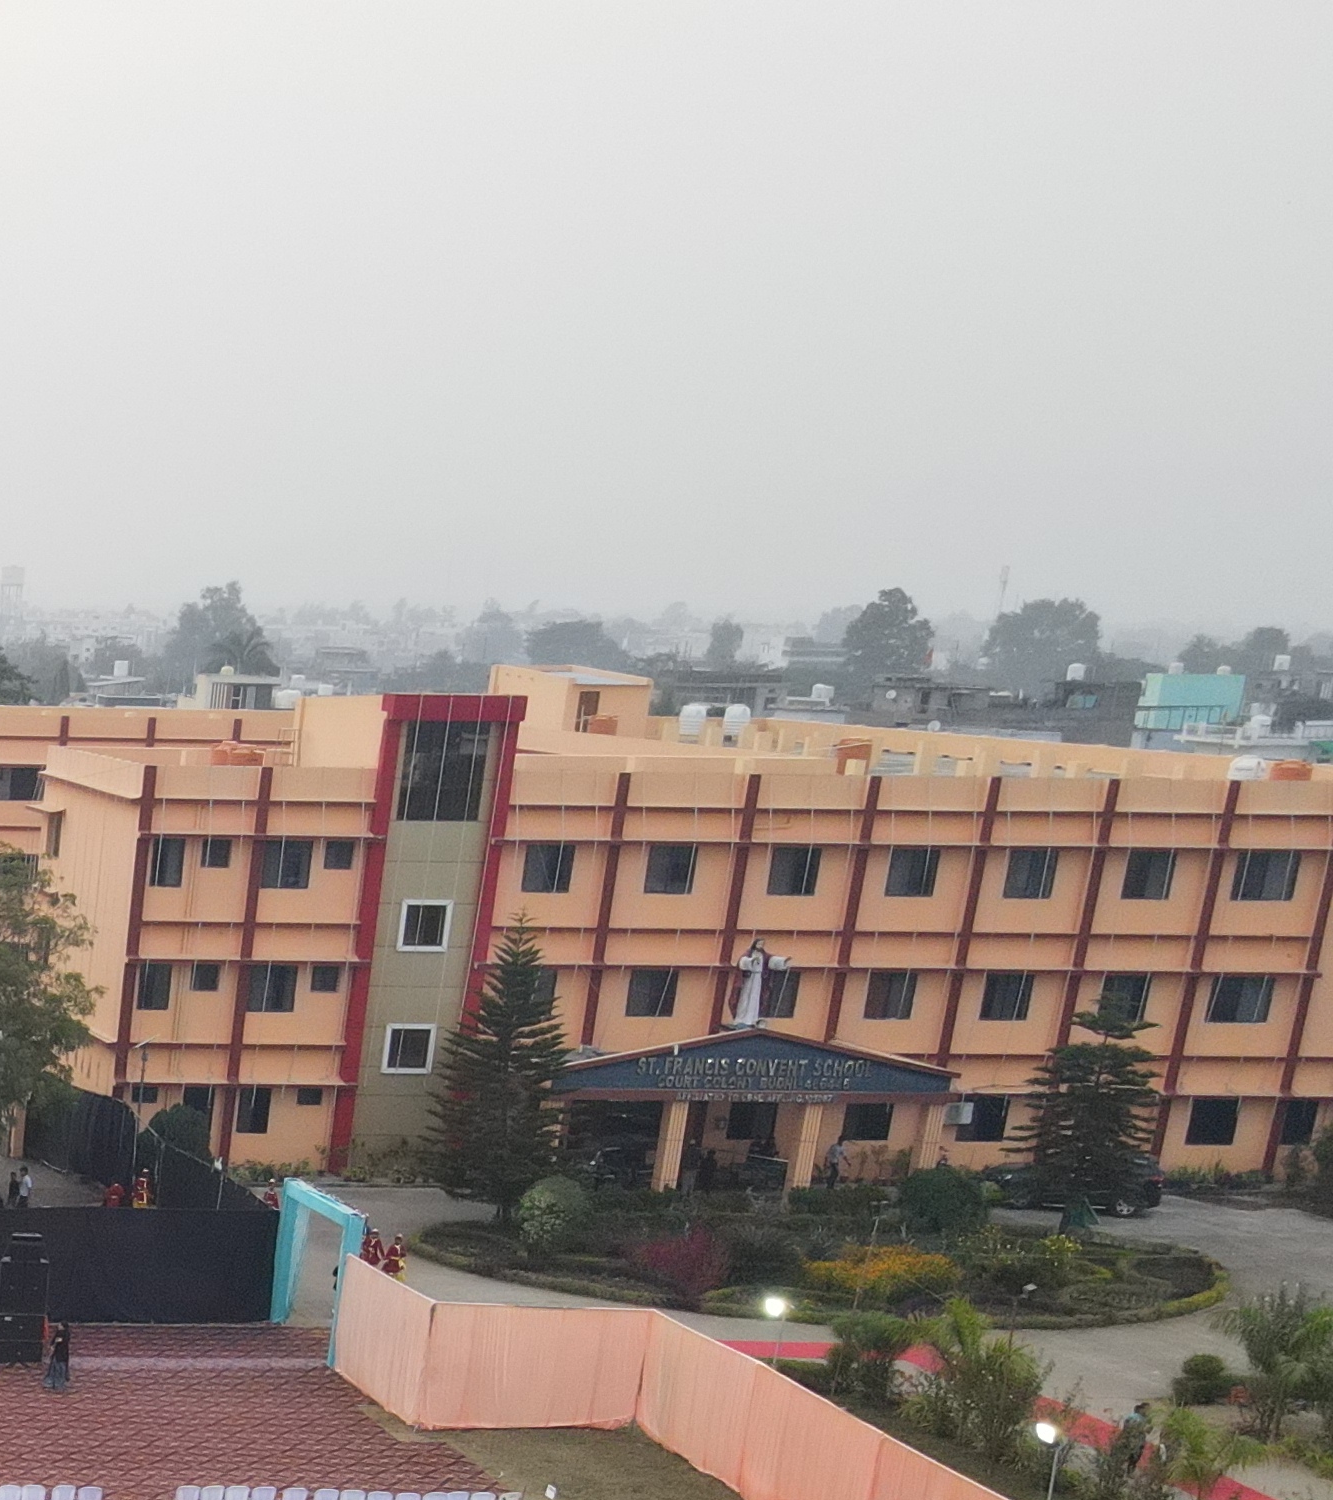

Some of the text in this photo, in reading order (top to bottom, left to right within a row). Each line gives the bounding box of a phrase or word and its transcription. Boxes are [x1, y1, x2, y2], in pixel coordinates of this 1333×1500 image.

[664, 1057, 730, 1075] FRANCIS
[735, 1058, 808, 1077] CONVENT
[813, 1060, 873, 1078] SCHOOL
[657, 1076, 700, 1088] COURT
[703, 1076, 754, 1089] COLONY
